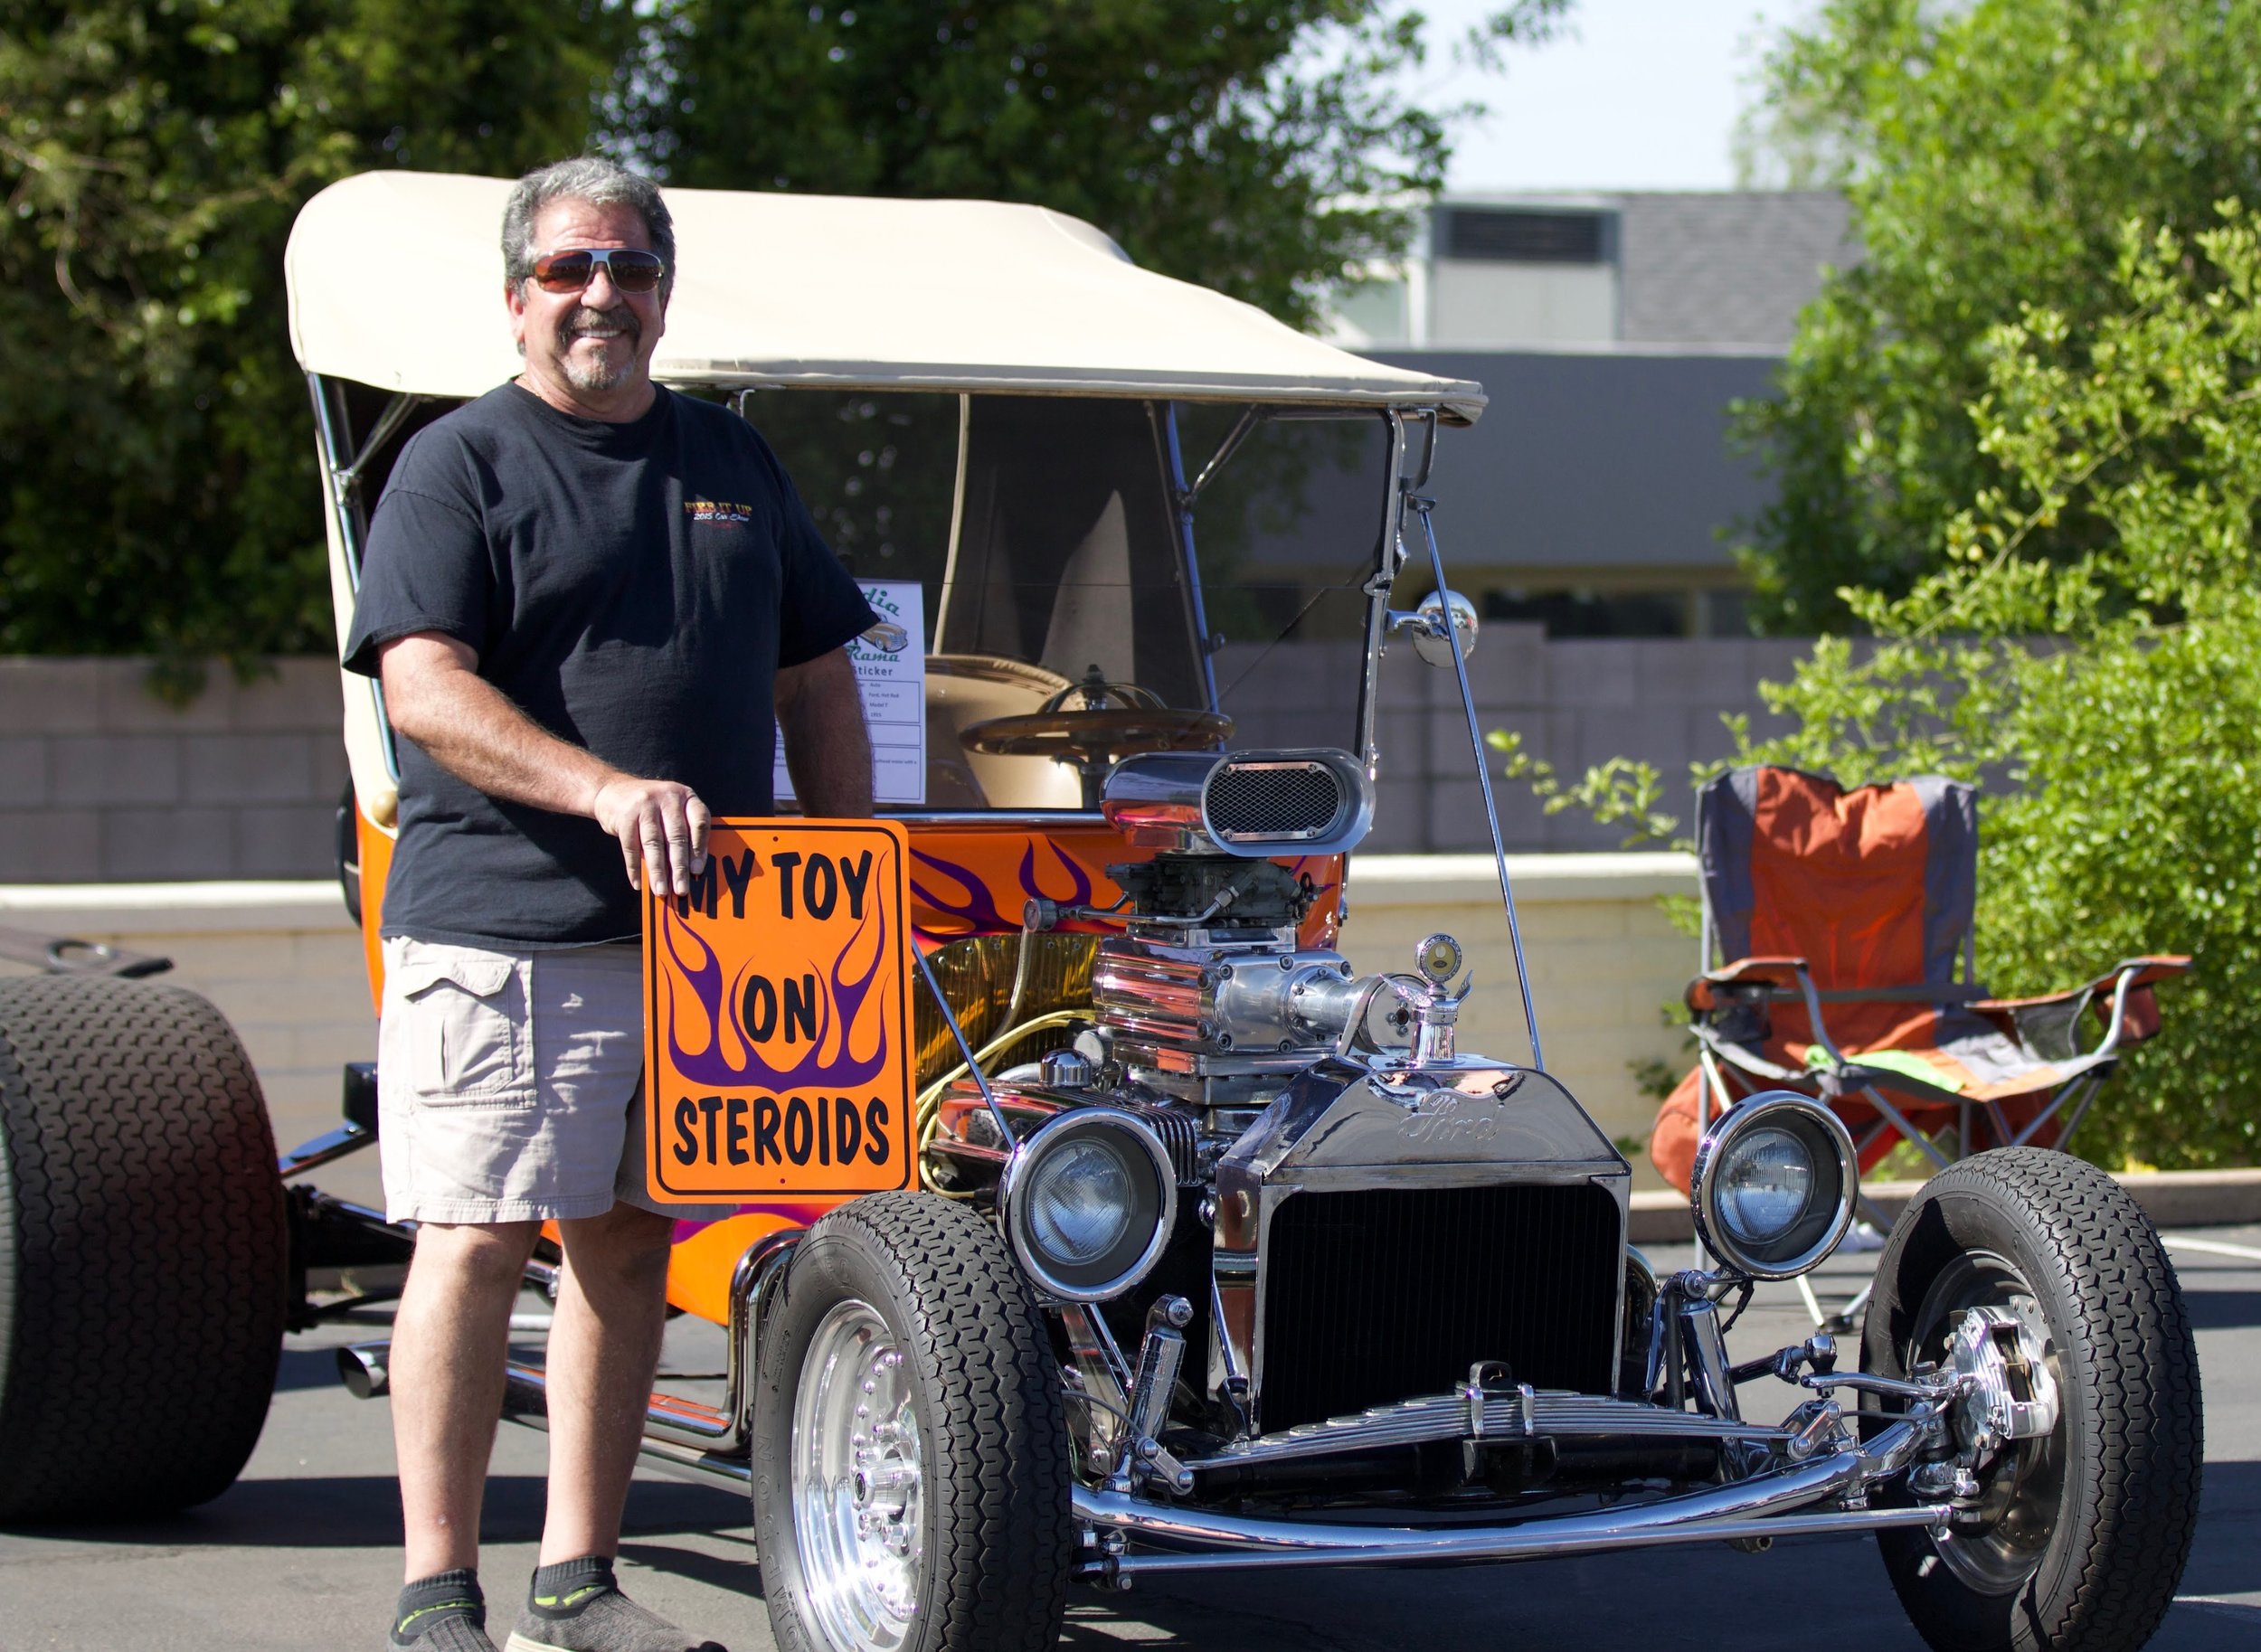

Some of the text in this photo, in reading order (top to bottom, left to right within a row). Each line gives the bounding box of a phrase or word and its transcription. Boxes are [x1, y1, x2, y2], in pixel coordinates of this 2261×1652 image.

[694, 513, 713, 521] 2015
[718, 502, 732, 514] IT
[735, 504, 752, 515] UP
[677, 848, 873, 920] MY TOY
[743, 974, 817, 1043] ON
[673, 1096, 889, 1166] STEROIDS
